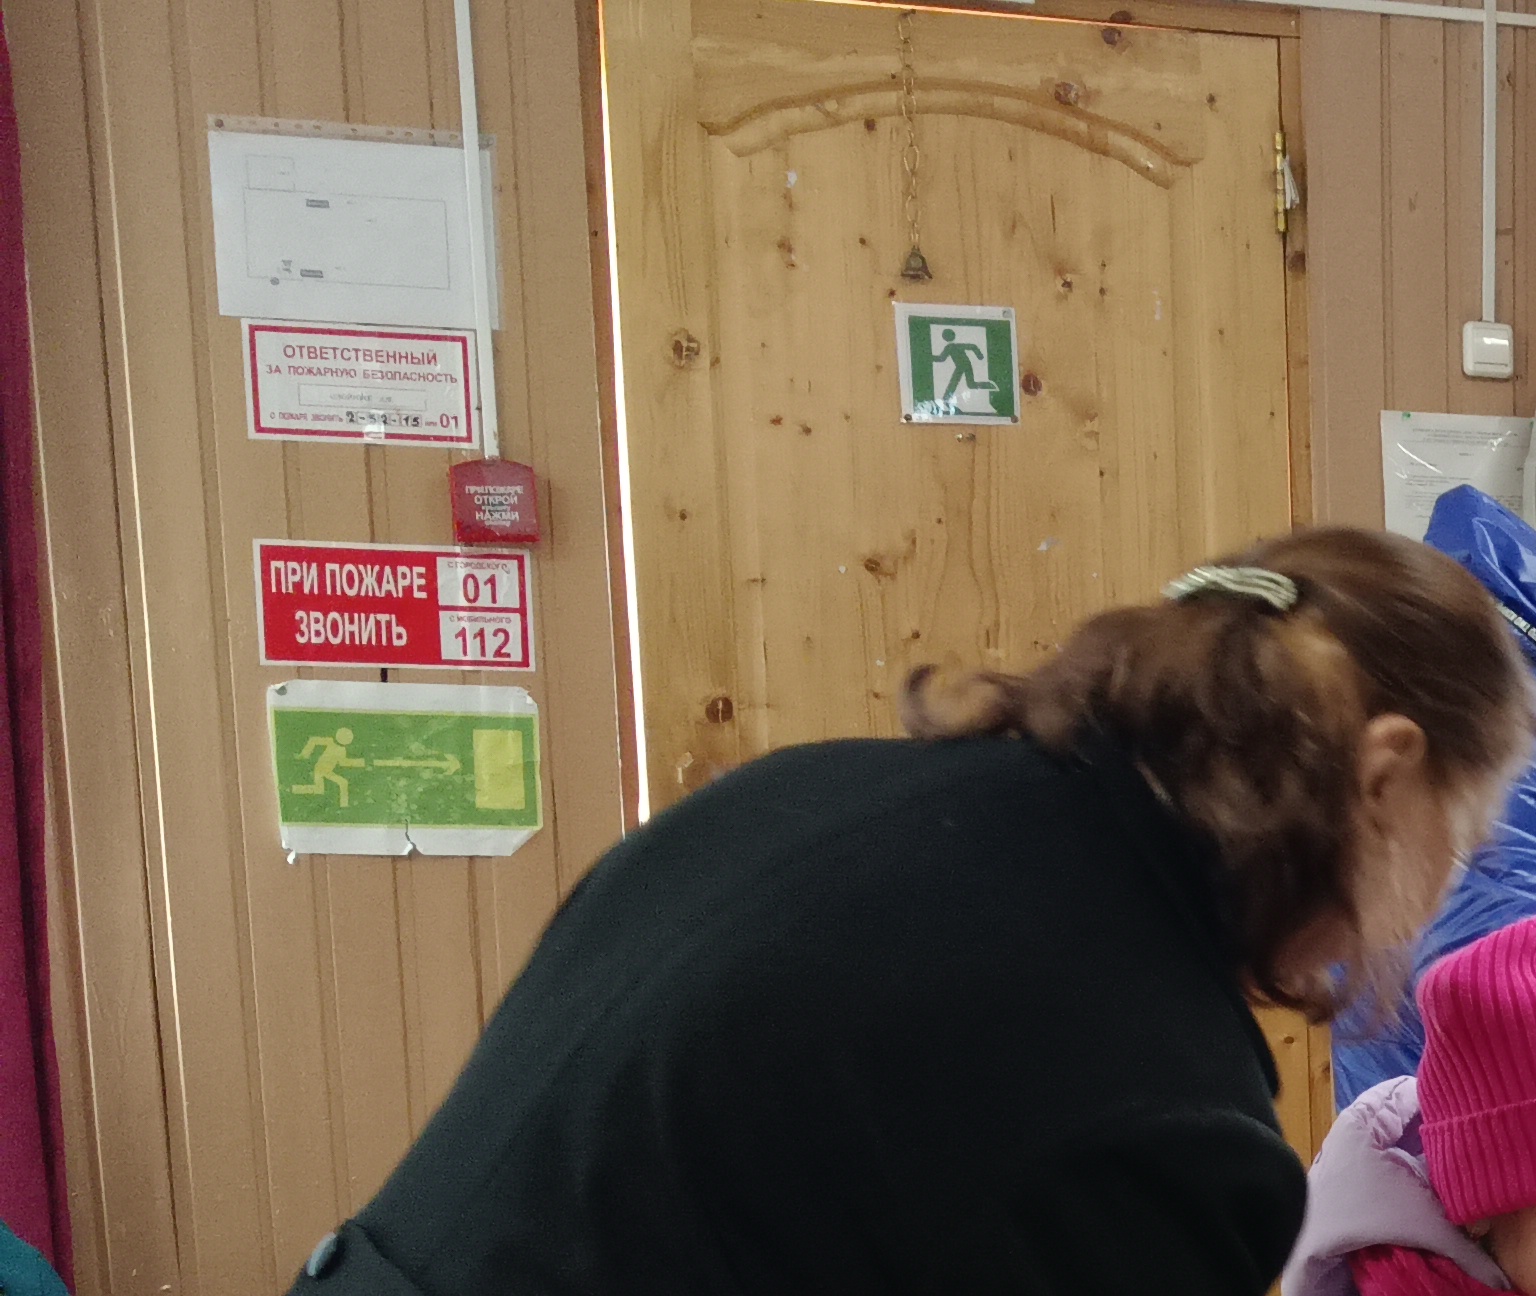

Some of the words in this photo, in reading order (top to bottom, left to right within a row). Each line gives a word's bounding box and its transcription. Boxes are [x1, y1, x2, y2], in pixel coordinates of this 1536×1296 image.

[283, 344, 438, 366] ОТВЕТСТВЕННЫЙ
[266, 364, 281, 375] ЗА
[288, 365, 357, 379] ПОЖАРНУЮ
[363, 369, 458, 384] БЕЗОПАСНОСТЬ
[439, 413, 459, 430] 01
[474, 493, 518, 505] ОТКРОЙ
[475, 510, 520, 521] НАЖМИ
[270, 560, 318, 595] ПРИ
[325, 562, 427, 600] ПОЖАРЕ
[462, 573, 498, 605] 01
[294, 609, 408, 647] ЗВОНИТЬ
[454, 626, 511, 659] 112
